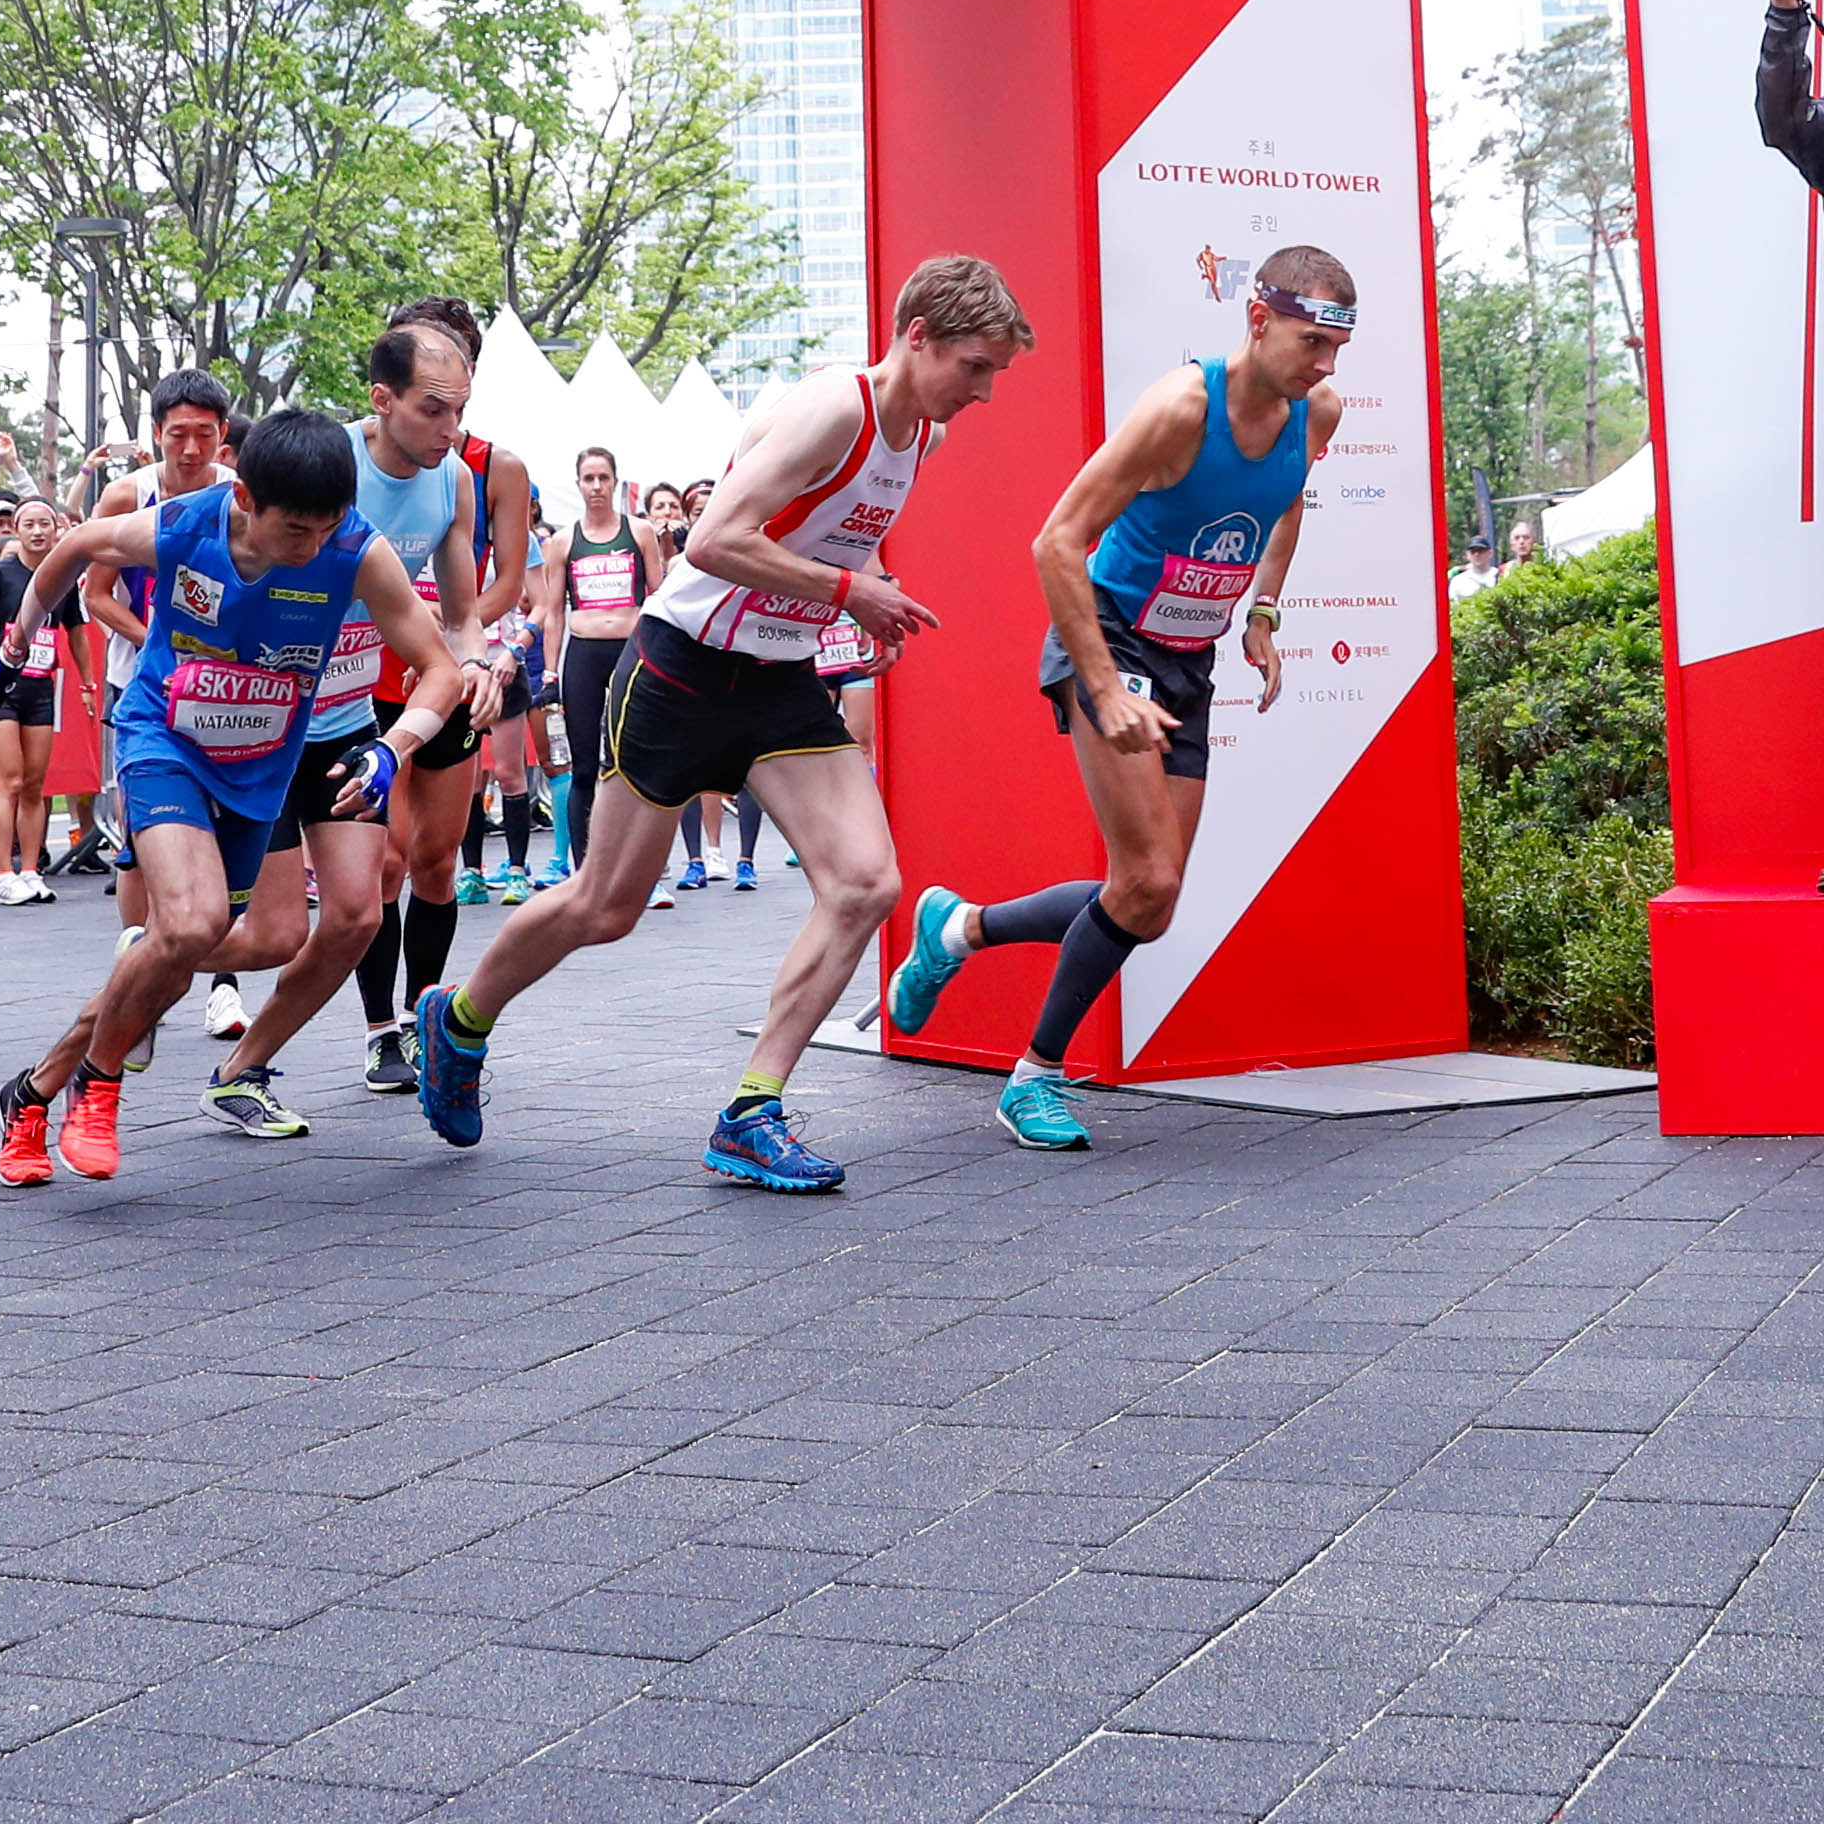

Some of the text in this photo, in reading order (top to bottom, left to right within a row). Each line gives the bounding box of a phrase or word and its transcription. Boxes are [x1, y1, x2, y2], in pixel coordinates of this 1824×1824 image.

[1137, 162, 1382, 193] LOTTE WORLD TOWER
[1250, 214, 1278, 233] 공인
[1340, 484, 1387, 499] orinbe
[850, 502, 895, 524] FLIGHT
[840, 516, 888, 538] CENTRE
[608, 557, 630, 573] RUN
[1177, 569, 1250, 596] SKY RUN
[763, 593, 838, 622] SKY RUN
[1280, 599, 1321, 609] LOTTE
[1322, 597, 1365, 608] WORLD
[1366, 596, 1398, 607] MALL
[333, 632, 362, 653] KY
[757, 624, 804, 643] BOURNE
[325, 657, 365, 680] BEKKALI
[196, 671, 247, 700] SKY
[247, 677, 295, 702] RUN
[1298, 688, 1365, 704] SIGNIEL
[193, 714, 272, 730] WATANABE
[1208, 735, 1237, 747] 화재단
